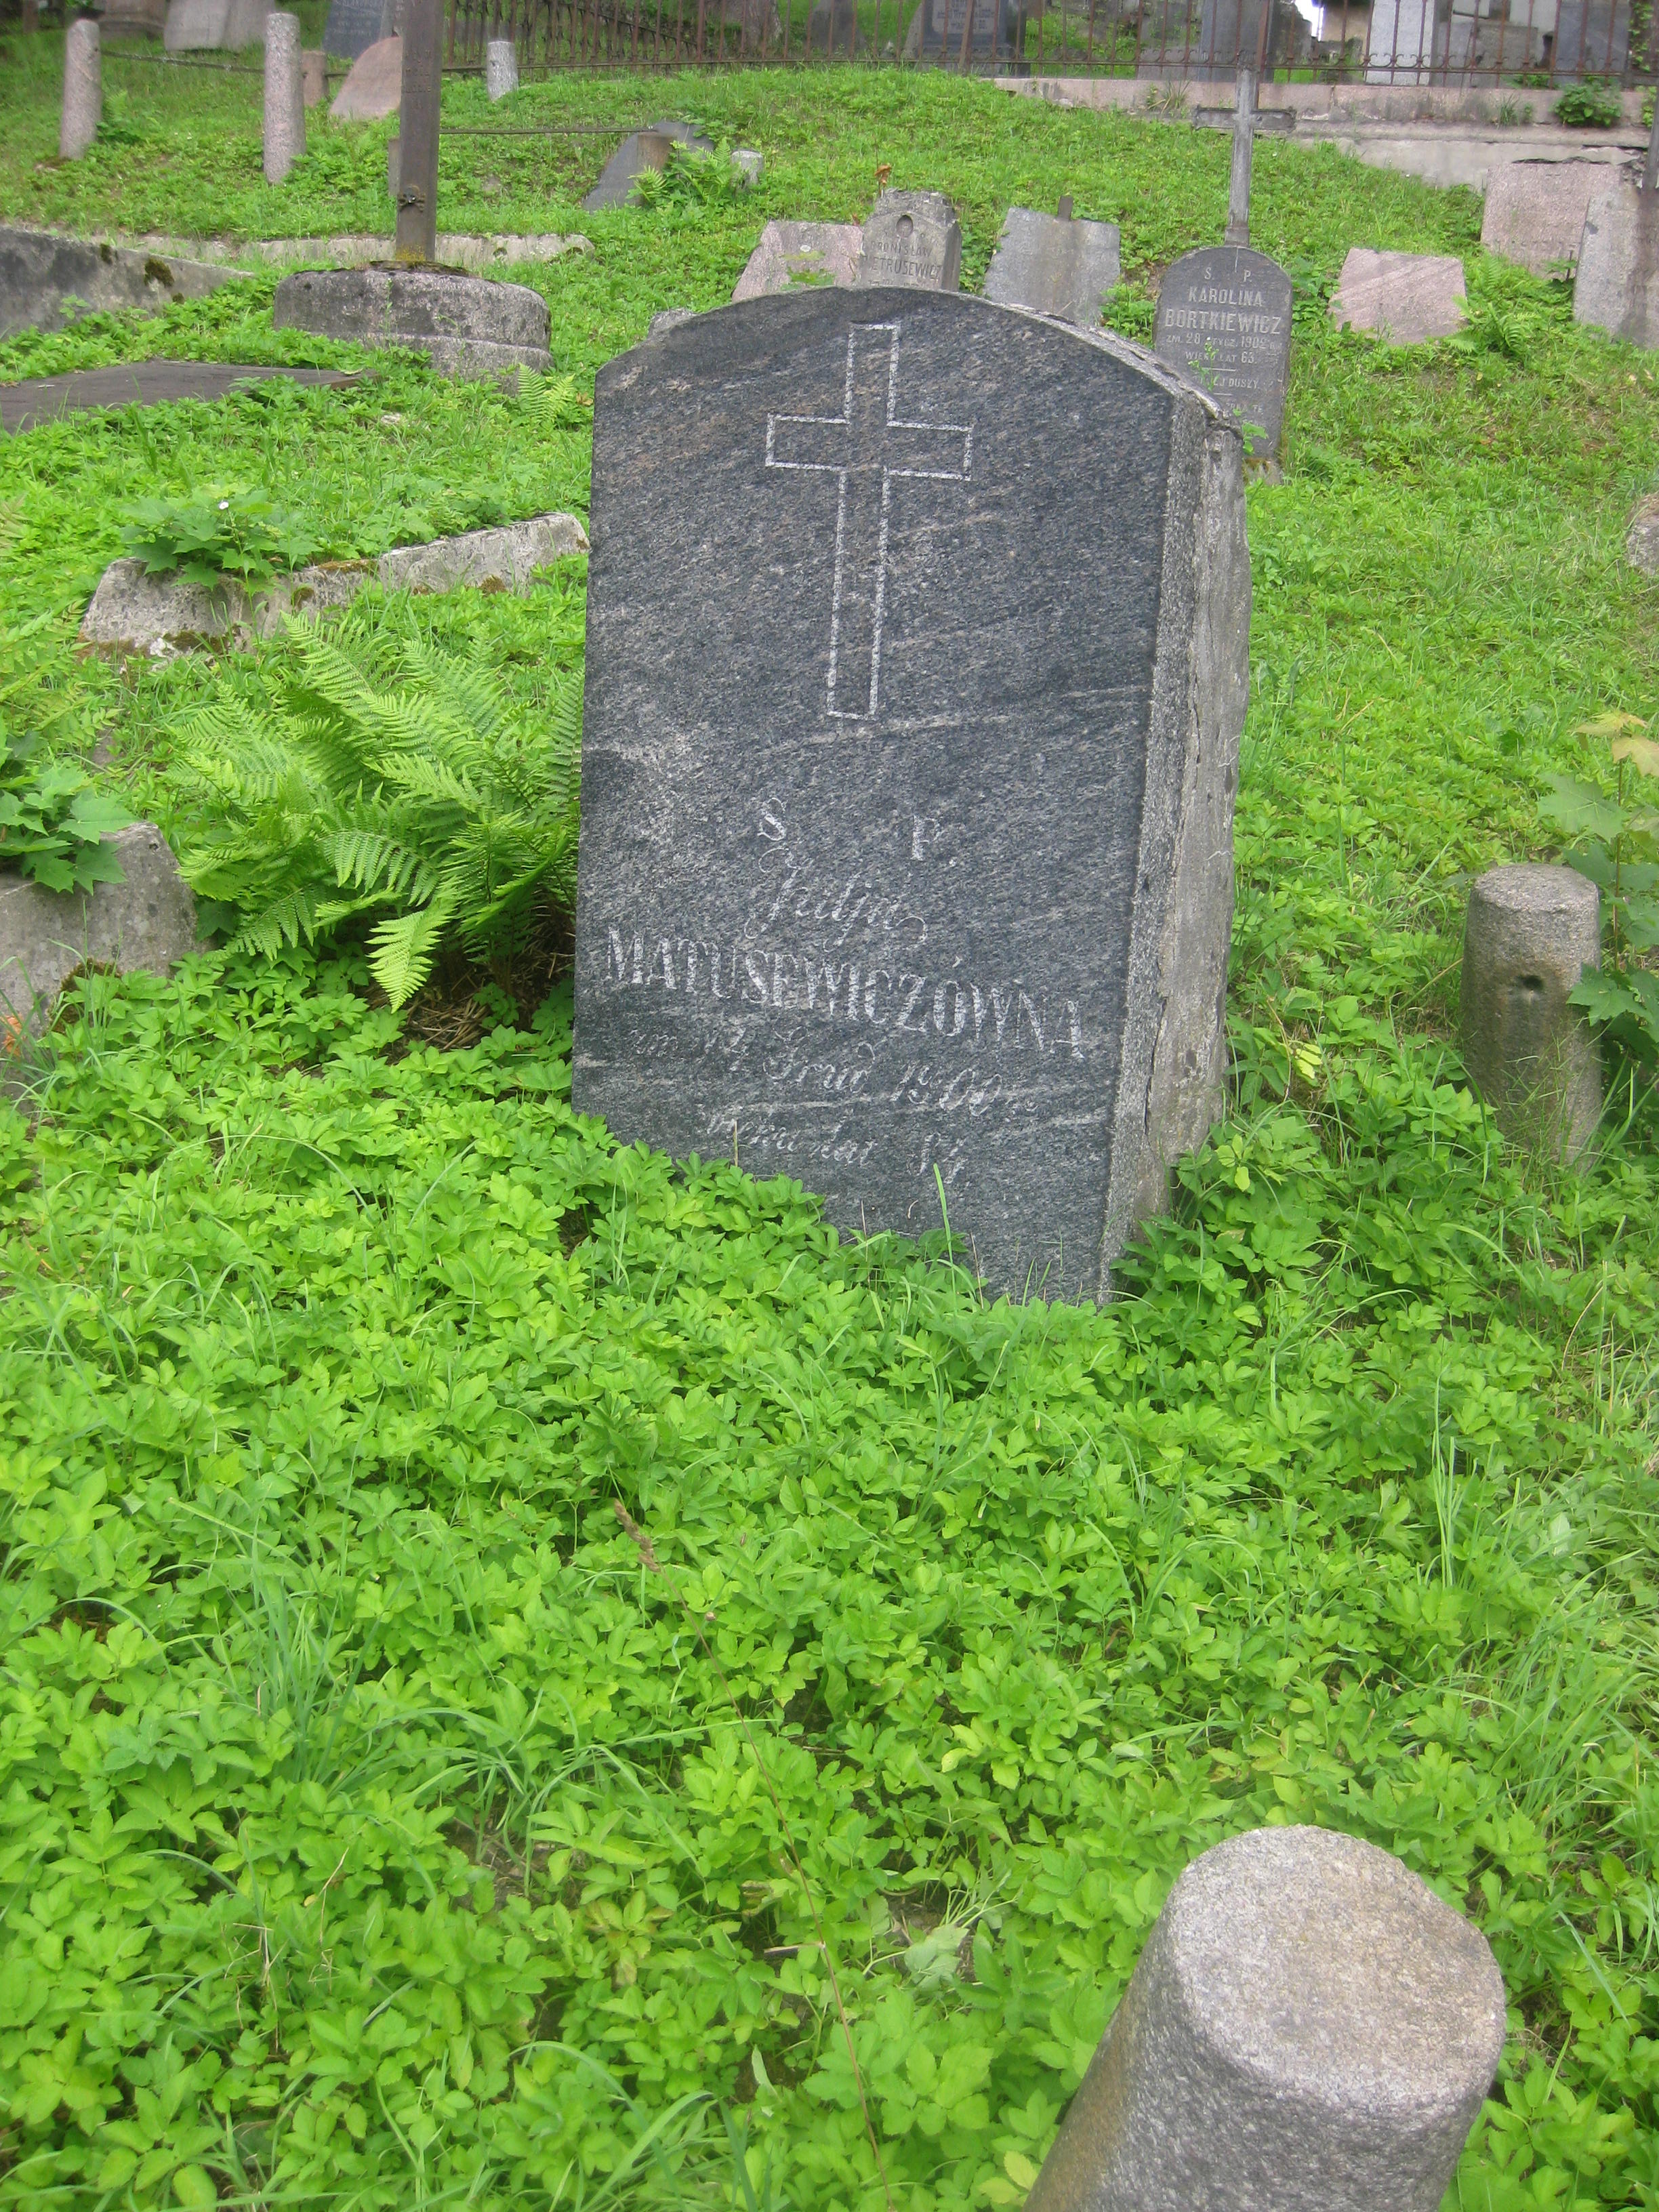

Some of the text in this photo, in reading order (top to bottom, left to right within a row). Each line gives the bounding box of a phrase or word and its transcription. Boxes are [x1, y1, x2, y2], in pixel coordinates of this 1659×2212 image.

[1188, 286, 1263, 307] KAROLINA
[1164, 308, 1282, 335] BORTKIEWICZ
[1220, 353, 1237, 363] LAT
